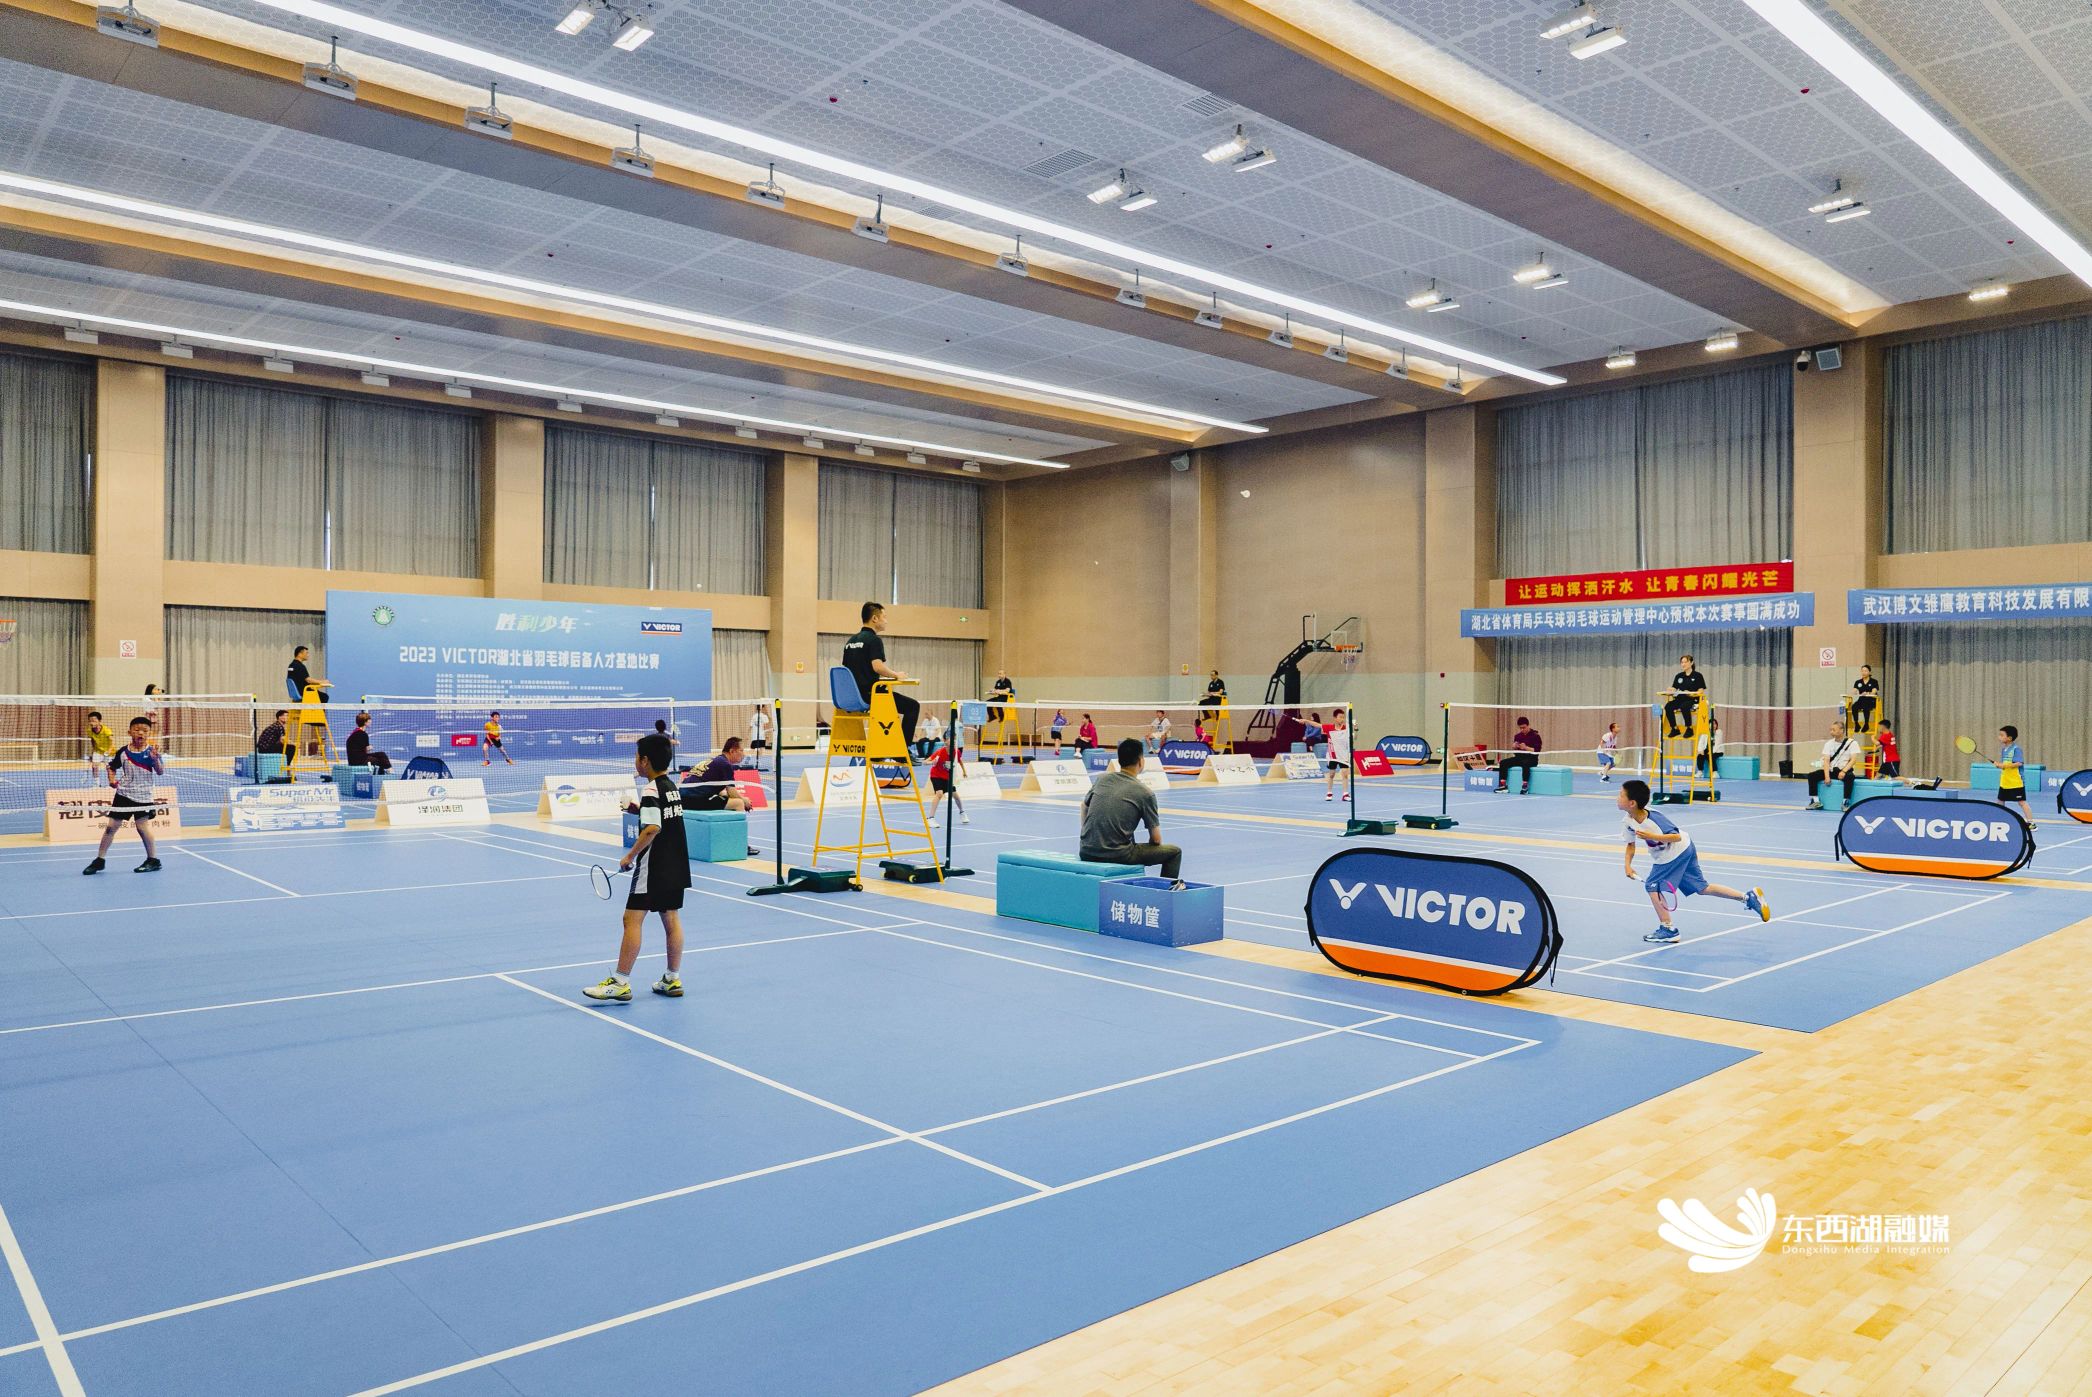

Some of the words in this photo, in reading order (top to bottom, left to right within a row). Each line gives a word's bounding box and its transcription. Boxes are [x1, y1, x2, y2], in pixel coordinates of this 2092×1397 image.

[1518, 580, 1634, 600] 让运动挥洒汗水
[1646, 569, 1780, 593] 让青春闪耀光芒
[1863, 586, 2091, 616] 武汉博文雏鹰教育科技发展有限
[495, 612, 579, 633] 胜利少年
[652, 623, 682, 632] VICTOR
[1471, 599, 1801, 632] 湖北省体育局乒乓球羽毛球运动管理中心预祝本次赛事圆满成功
[400, 645, 436, 663] 2023
[842, 744, 866, 754] VICTOR
[1175, 750, 1208, 760] VICTOR
[1391, 743, 1424, 753] VICTOR
[1892, 816, 2011, 843] VICTOR
[1110, 899, 1161, 930] 储物筐
[1375, 883, 1526, 936] VICTOR
